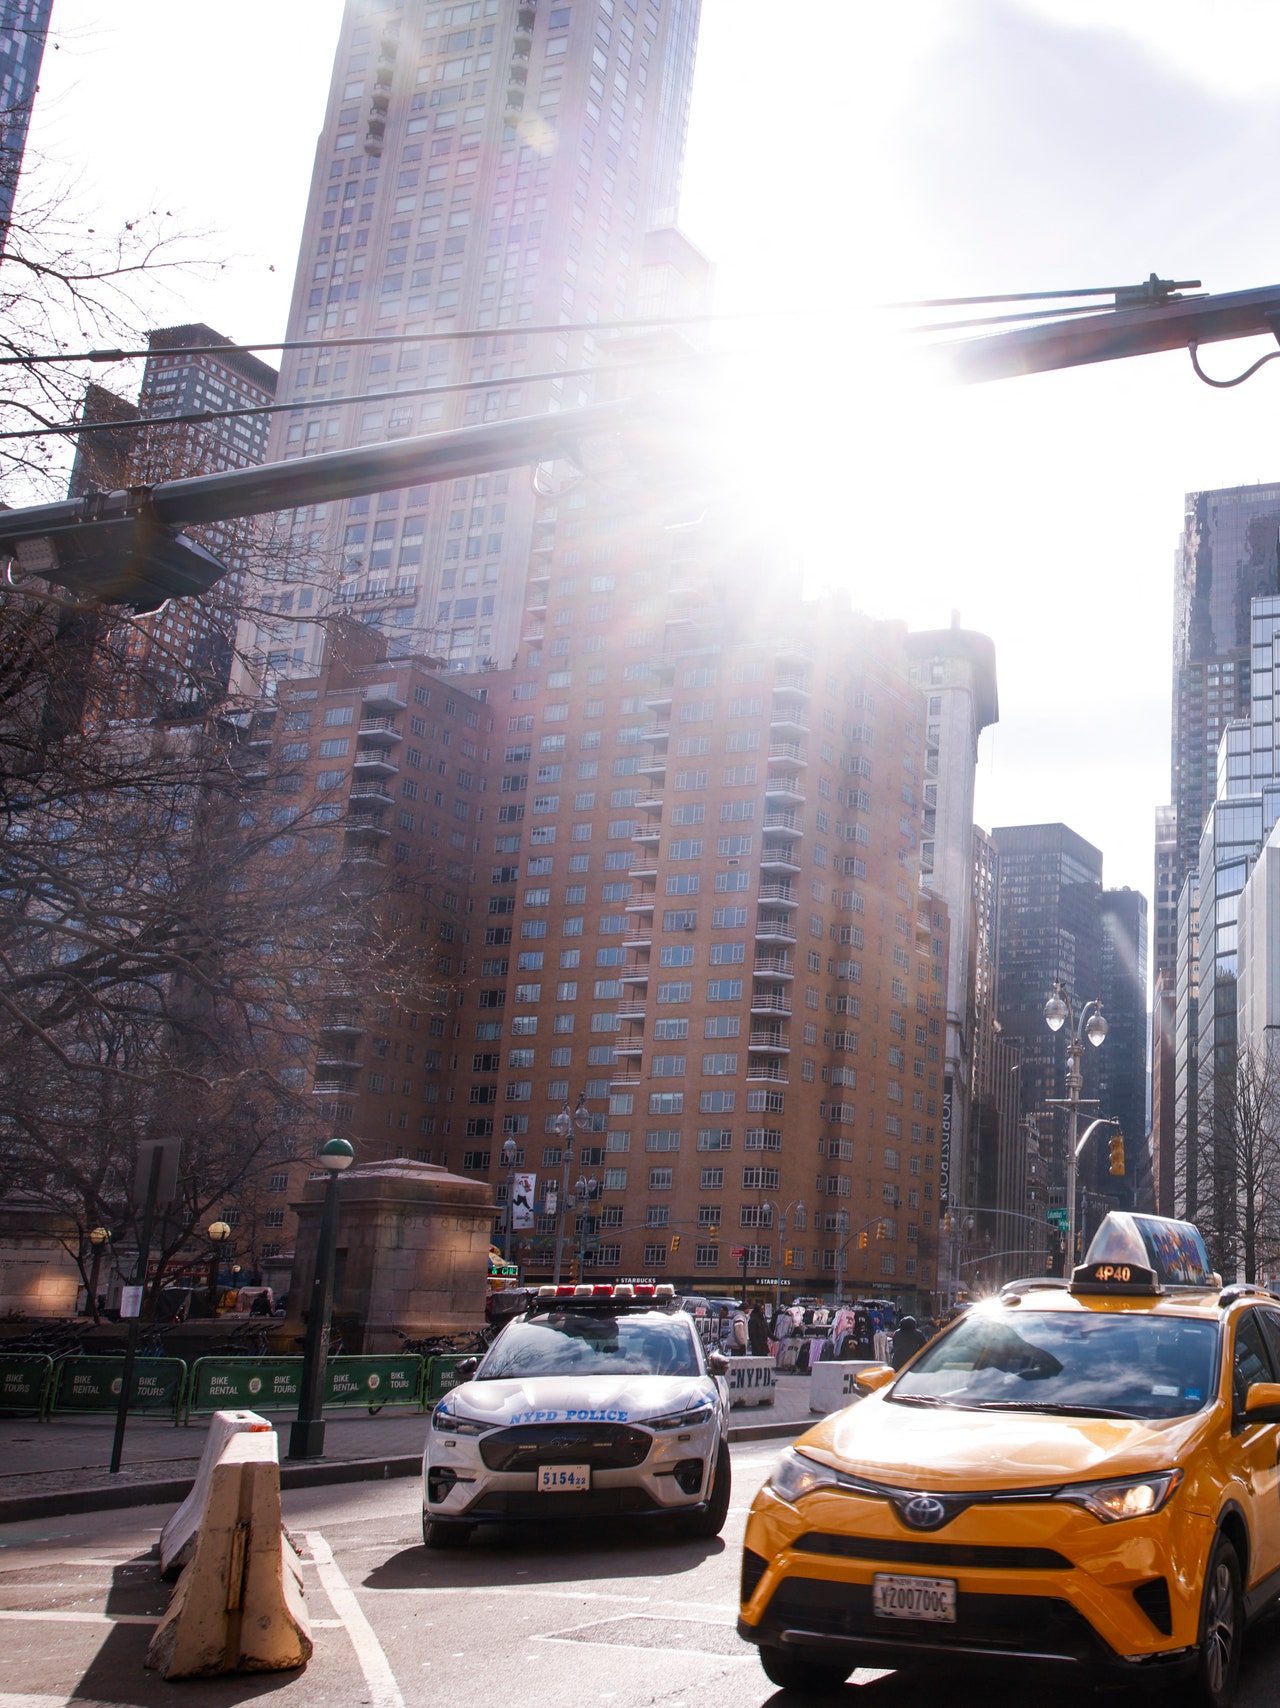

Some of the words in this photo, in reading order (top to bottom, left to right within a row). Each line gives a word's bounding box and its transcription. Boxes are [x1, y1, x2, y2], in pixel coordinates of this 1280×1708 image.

[940, 1093, 952, 1201] NORDSTROM
[1095, 1265, 1131, 1281] 4P40
[5, 1374, 24, 1382] BIKE
[74, 1375, 92, 1384] BIKE
[274, 1375, 291, 1384] BIKE
[333, 1374, 350, 1383] BIKE
[390, 1371, 405, 1380] BIKE
[440, 1371, 455, 1380] BIKE
[736, 1367, 771, 1389] NYPD
[138, 1376, 157, 1386] BIKE
[211, 1376, 229, 1386] BIKE
[390, 1380, 410, 1389] TOURS
[3, 1383, 30, 1393] TOURS
[72, 1385, 100, 1394] RENTAL
[137, 1387, 164, 1397] TOURS
[209, 1385, 239, 1395] RENTAL
[273, 1384, 297, 1394] TOURS
[333, 1383, 360, 1392] RENTAL
[509, 1411, 558, 1425] NYPD
[565, 1410, 628, 1422] POLICE
[543, 1472, 575, 1486] 5154
